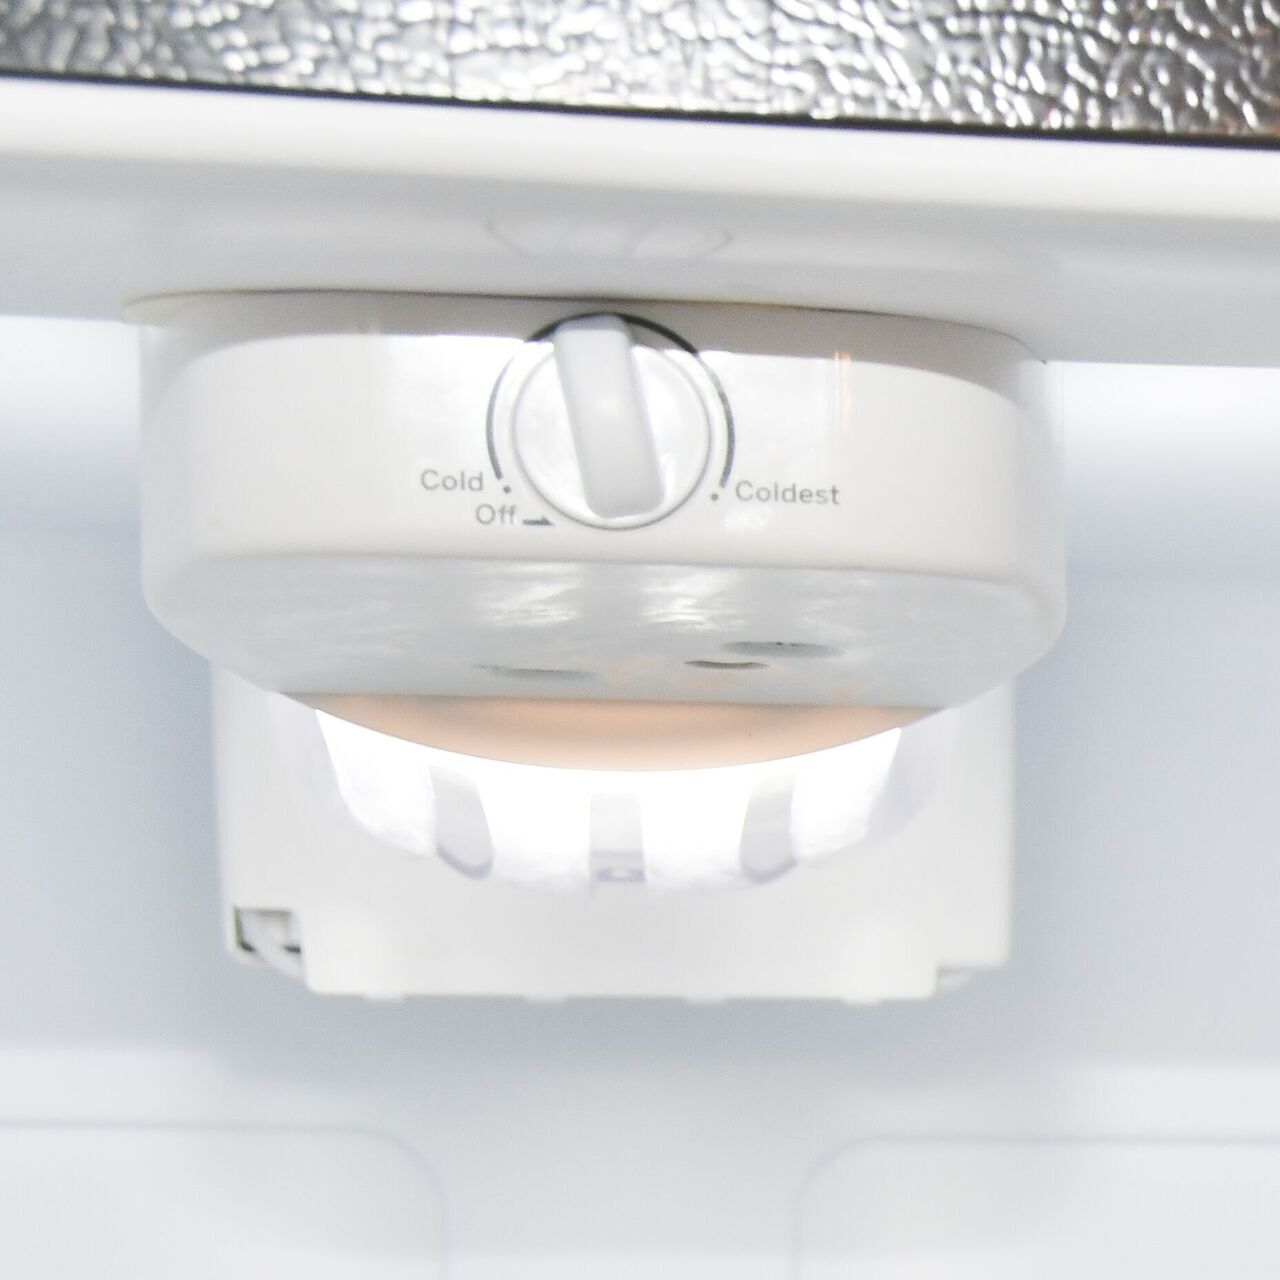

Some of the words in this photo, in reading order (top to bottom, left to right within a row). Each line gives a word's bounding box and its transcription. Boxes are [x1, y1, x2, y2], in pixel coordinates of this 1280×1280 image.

[419, 469, 484, 492] Cold
[735, 481, 840, 506] Coldest
[475, 504, 517, 525] Off
